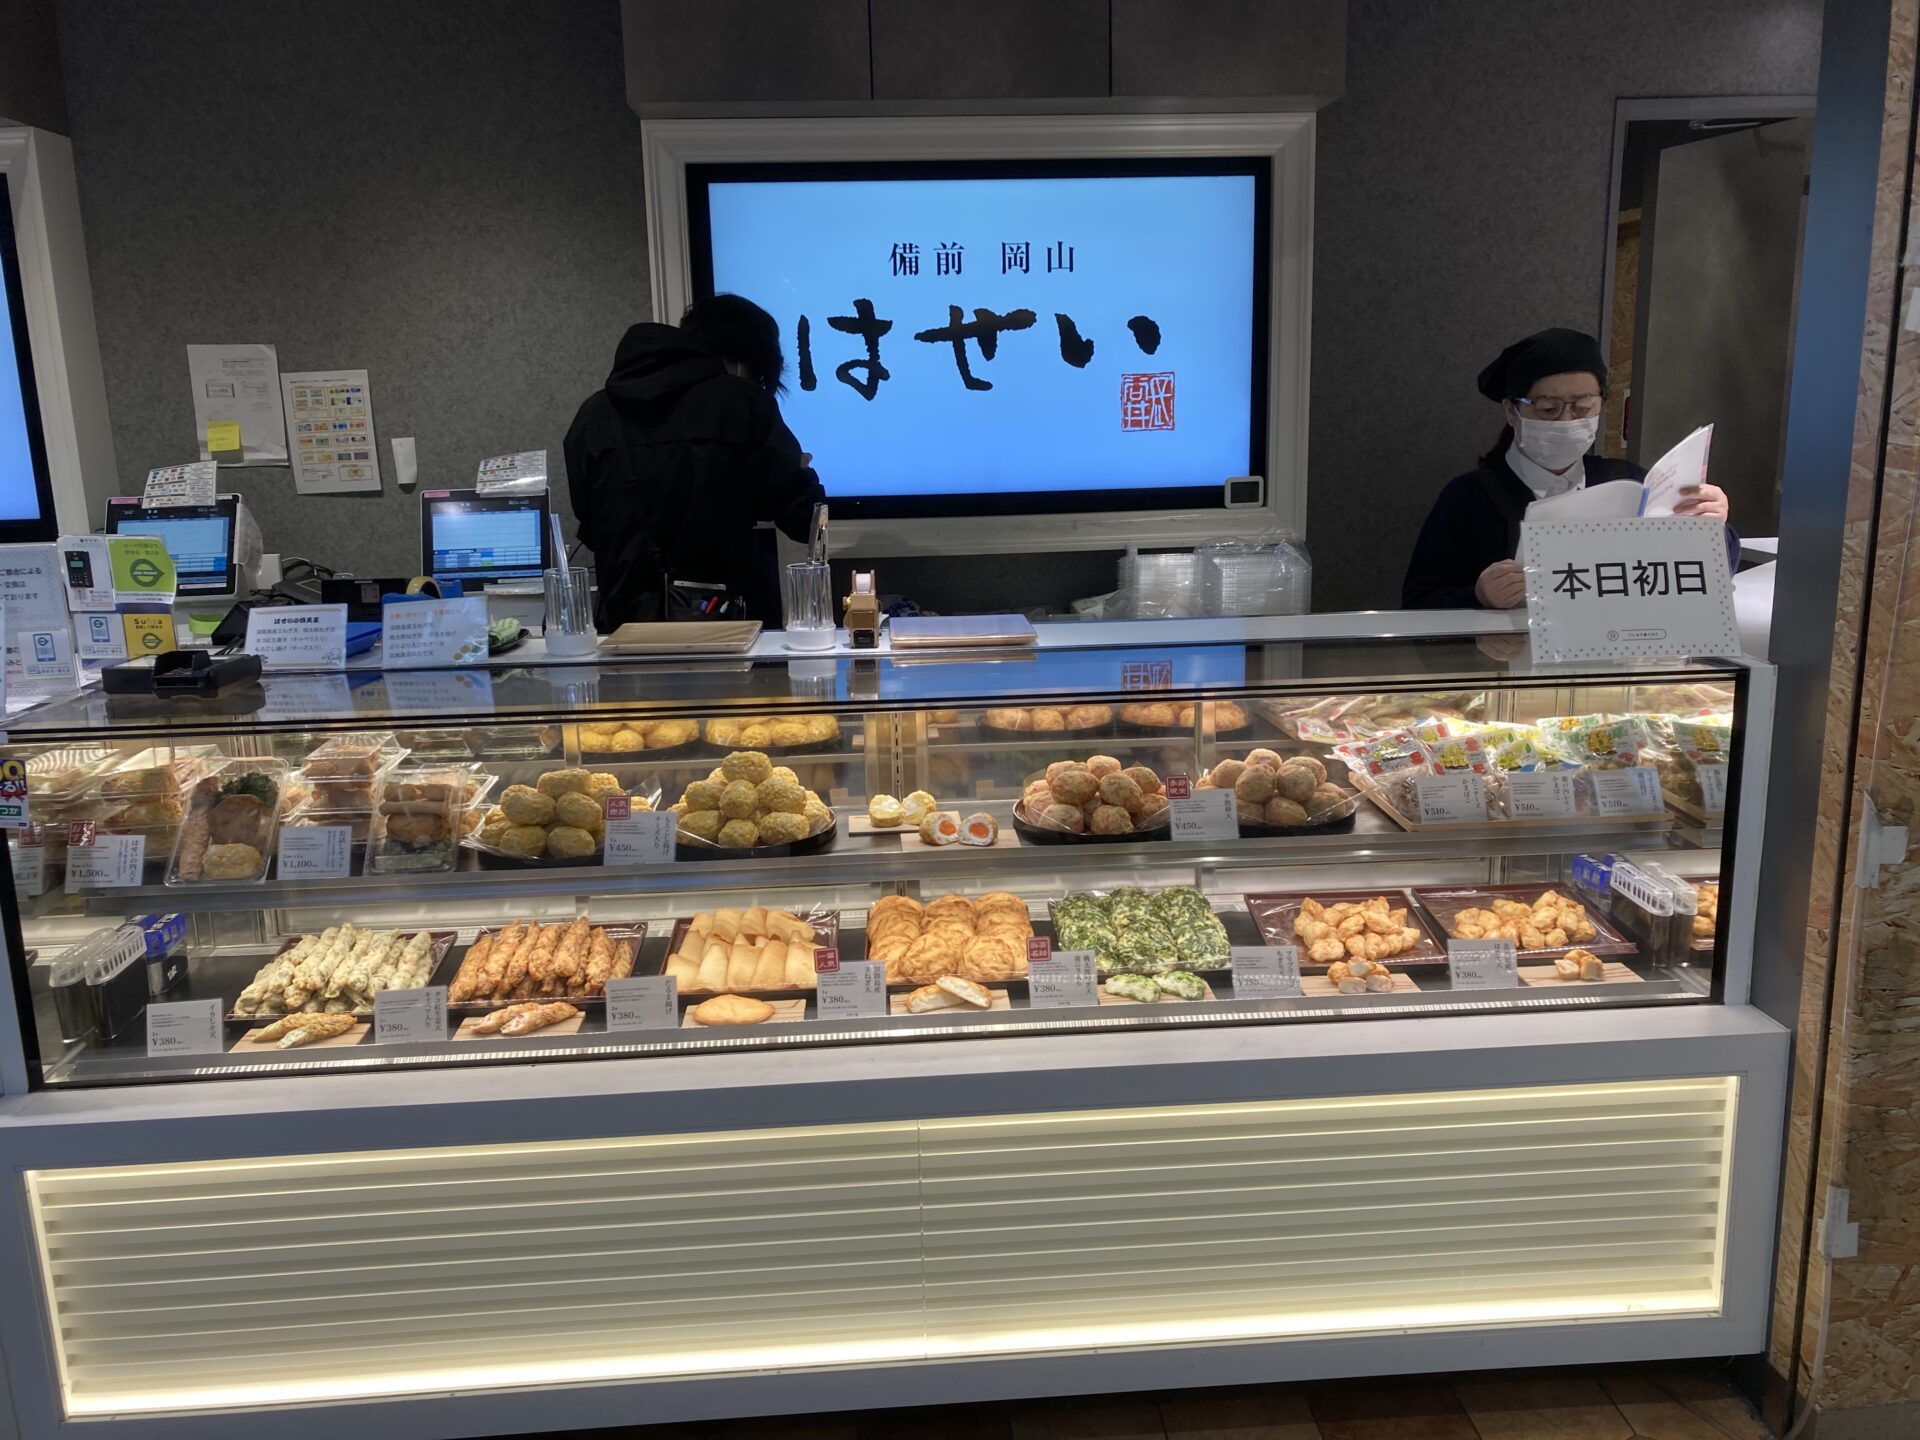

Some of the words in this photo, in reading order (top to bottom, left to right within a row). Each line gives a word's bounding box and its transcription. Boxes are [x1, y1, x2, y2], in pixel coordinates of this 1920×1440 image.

[888, 241, 965, 276] 備前
[1001, 241, 1075, 274] 岡山
[797, 297, 1162, 401] はせい
[1552, 559, 1707, 600] 本日初日
